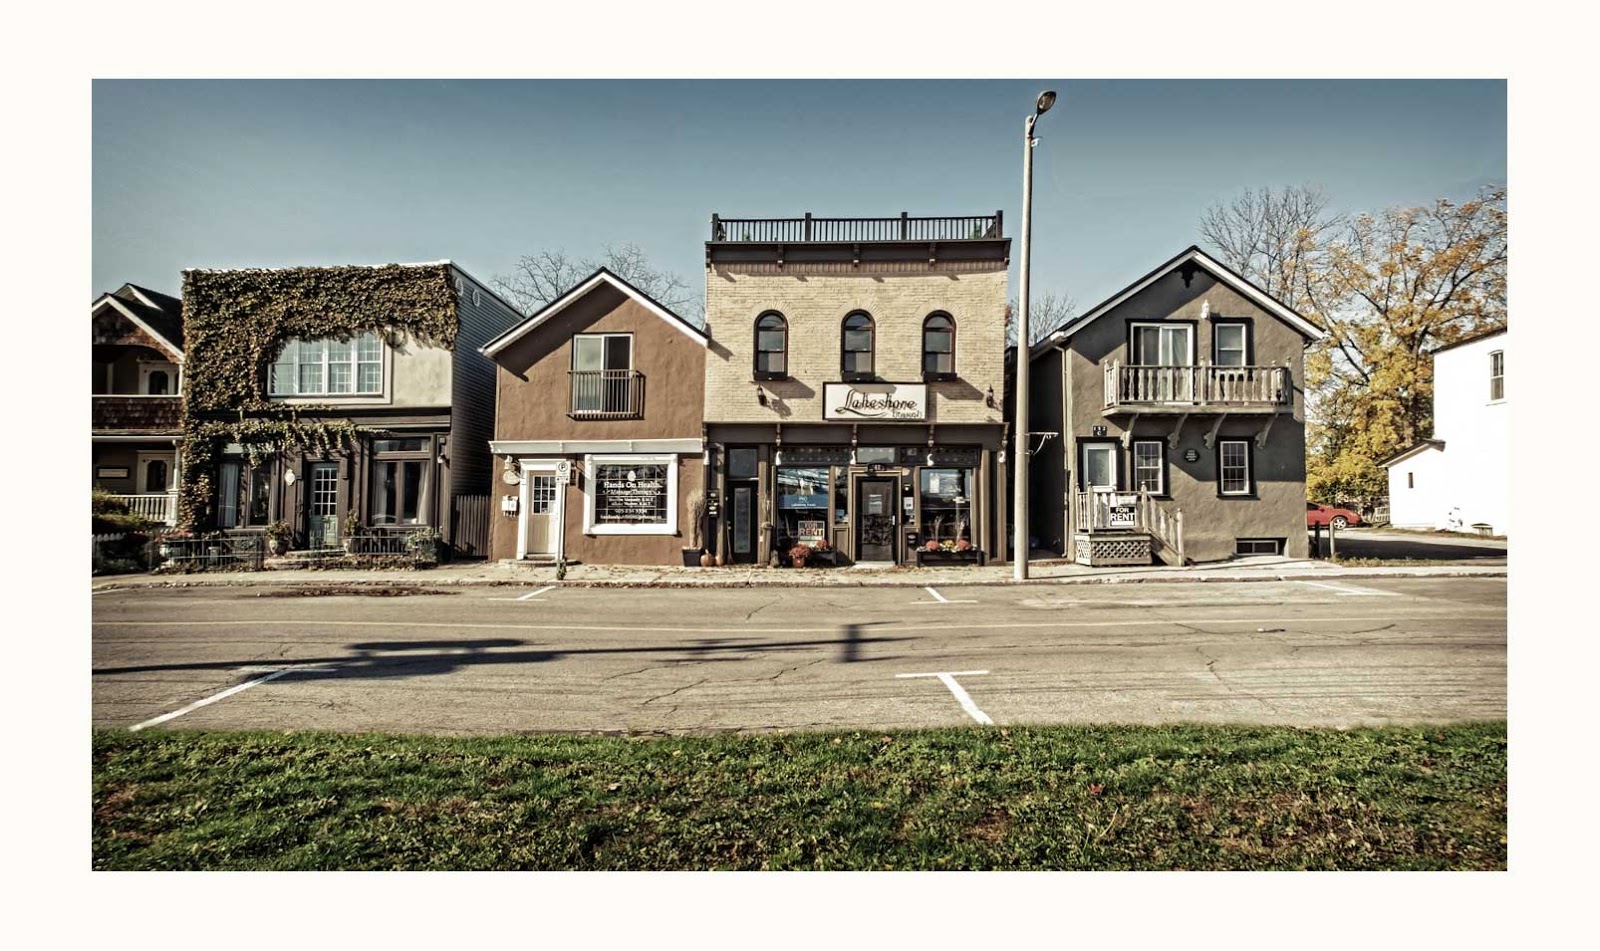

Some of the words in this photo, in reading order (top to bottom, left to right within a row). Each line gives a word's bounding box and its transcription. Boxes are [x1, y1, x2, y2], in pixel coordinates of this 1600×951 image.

[834, 389, 917, 417] Lakeshore
[1110, 513, 1135, 521] RENT
[804, 521, 818, 529] FOR
[799, 528, 823, 536] RENT
